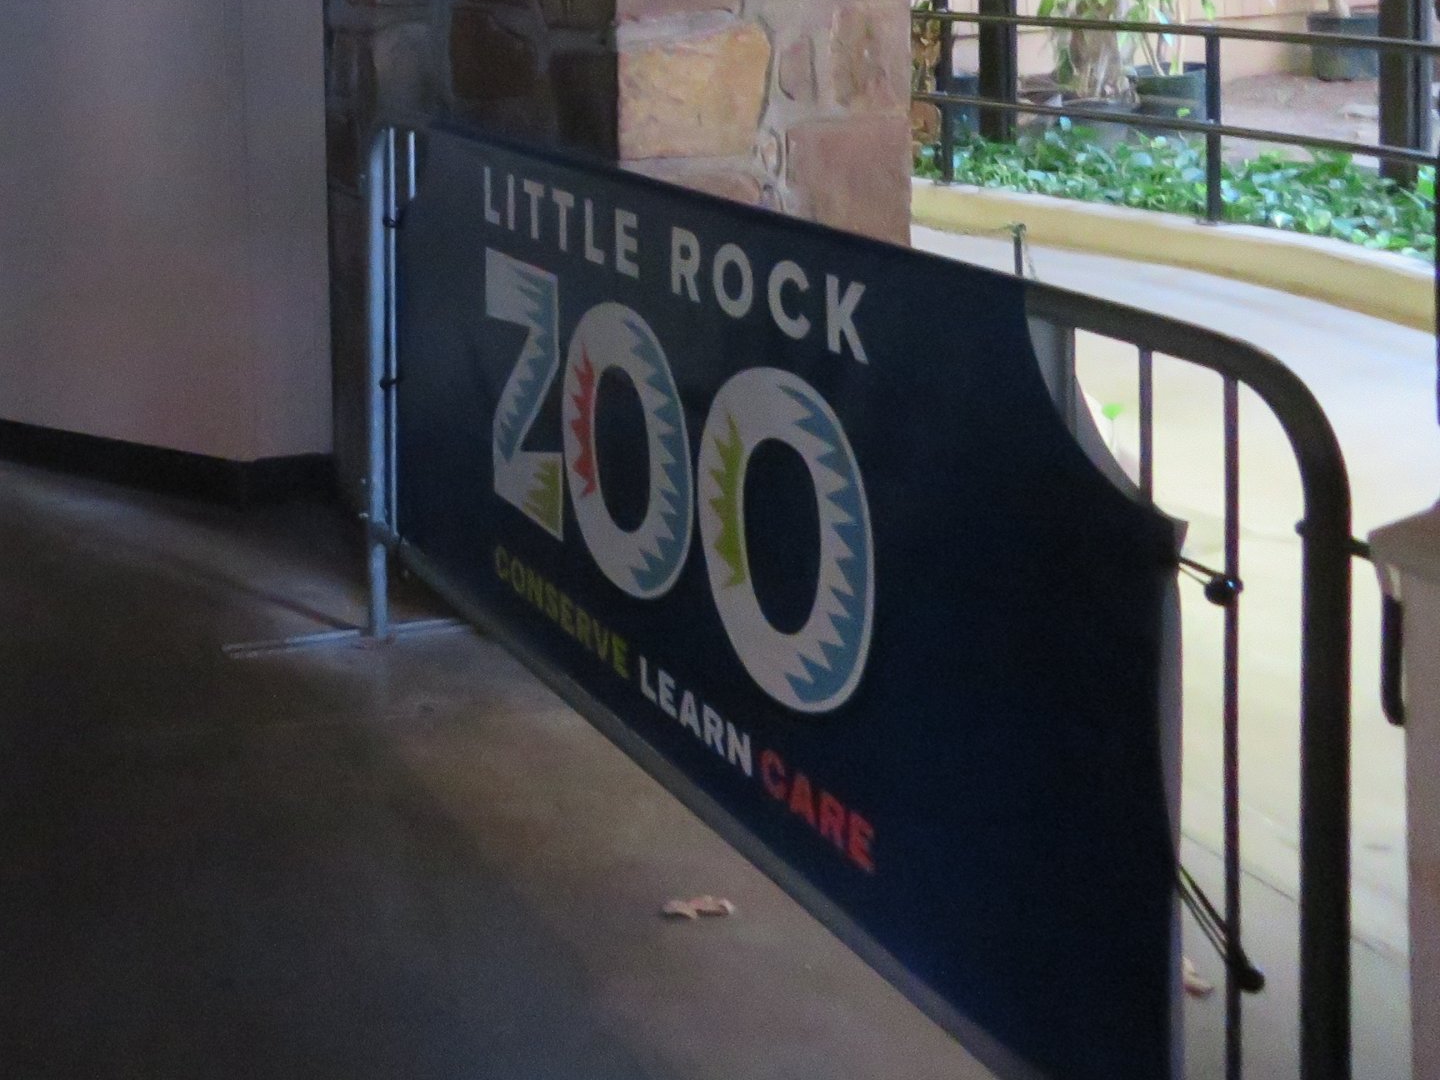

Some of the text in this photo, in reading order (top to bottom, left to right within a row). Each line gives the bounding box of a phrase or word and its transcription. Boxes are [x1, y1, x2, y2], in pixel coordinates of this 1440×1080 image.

[483, 165, 869, 365] LITTLE ROCK
[485, 246, 875, 713] ZOO
[495, 545, 876, 873] CONSERVE LEARN CARE
